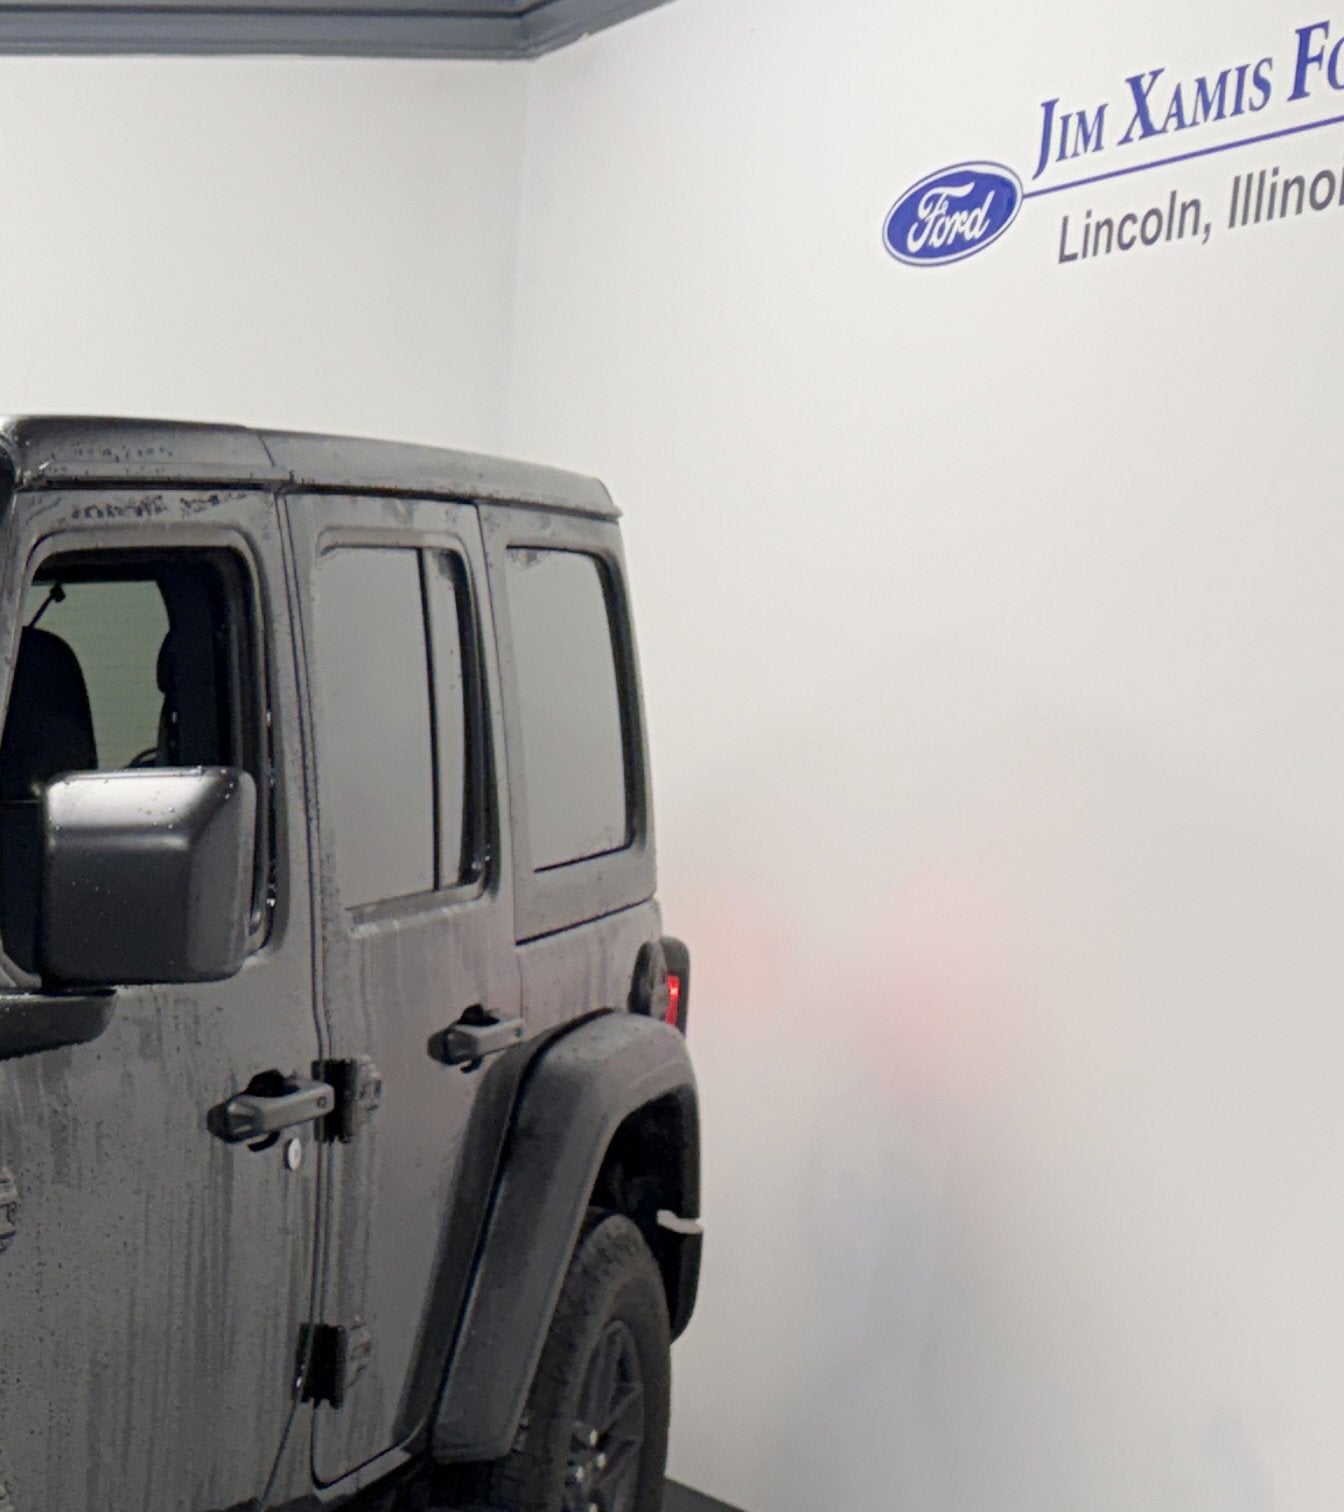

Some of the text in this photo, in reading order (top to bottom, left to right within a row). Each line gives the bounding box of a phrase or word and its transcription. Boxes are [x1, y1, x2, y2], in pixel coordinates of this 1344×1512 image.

[1031, 98, 1109, 181] JIM
[1117, 57, 1273, 146] XAMIS
[906, 180, 996, 253] Ford
[1058, 189, 1212, 264] Lincoln,
